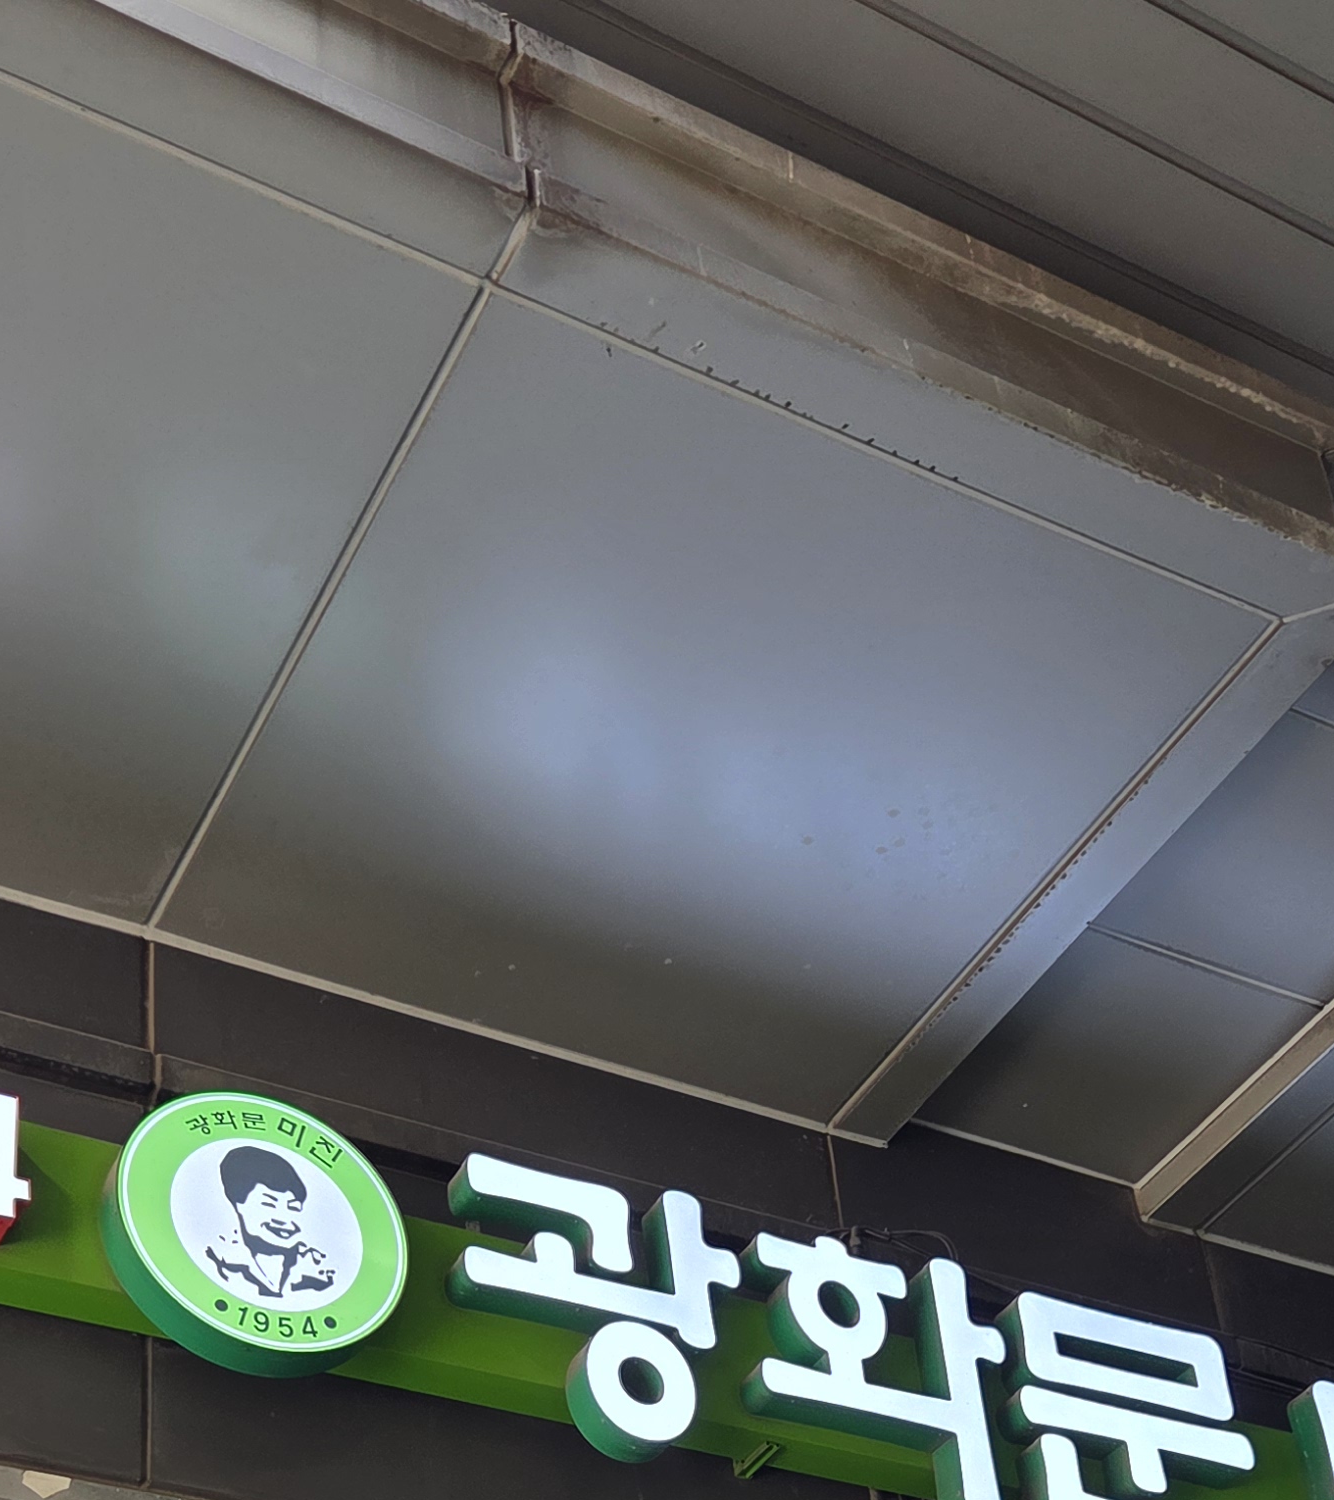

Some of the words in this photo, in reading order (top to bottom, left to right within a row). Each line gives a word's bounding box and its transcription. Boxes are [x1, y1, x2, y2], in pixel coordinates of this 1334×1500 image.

[185, 1109, 267, 1136] 광화문
[277, 1116, 344, 1169] 미진
[236, 1306, 319, 1338] 1954
